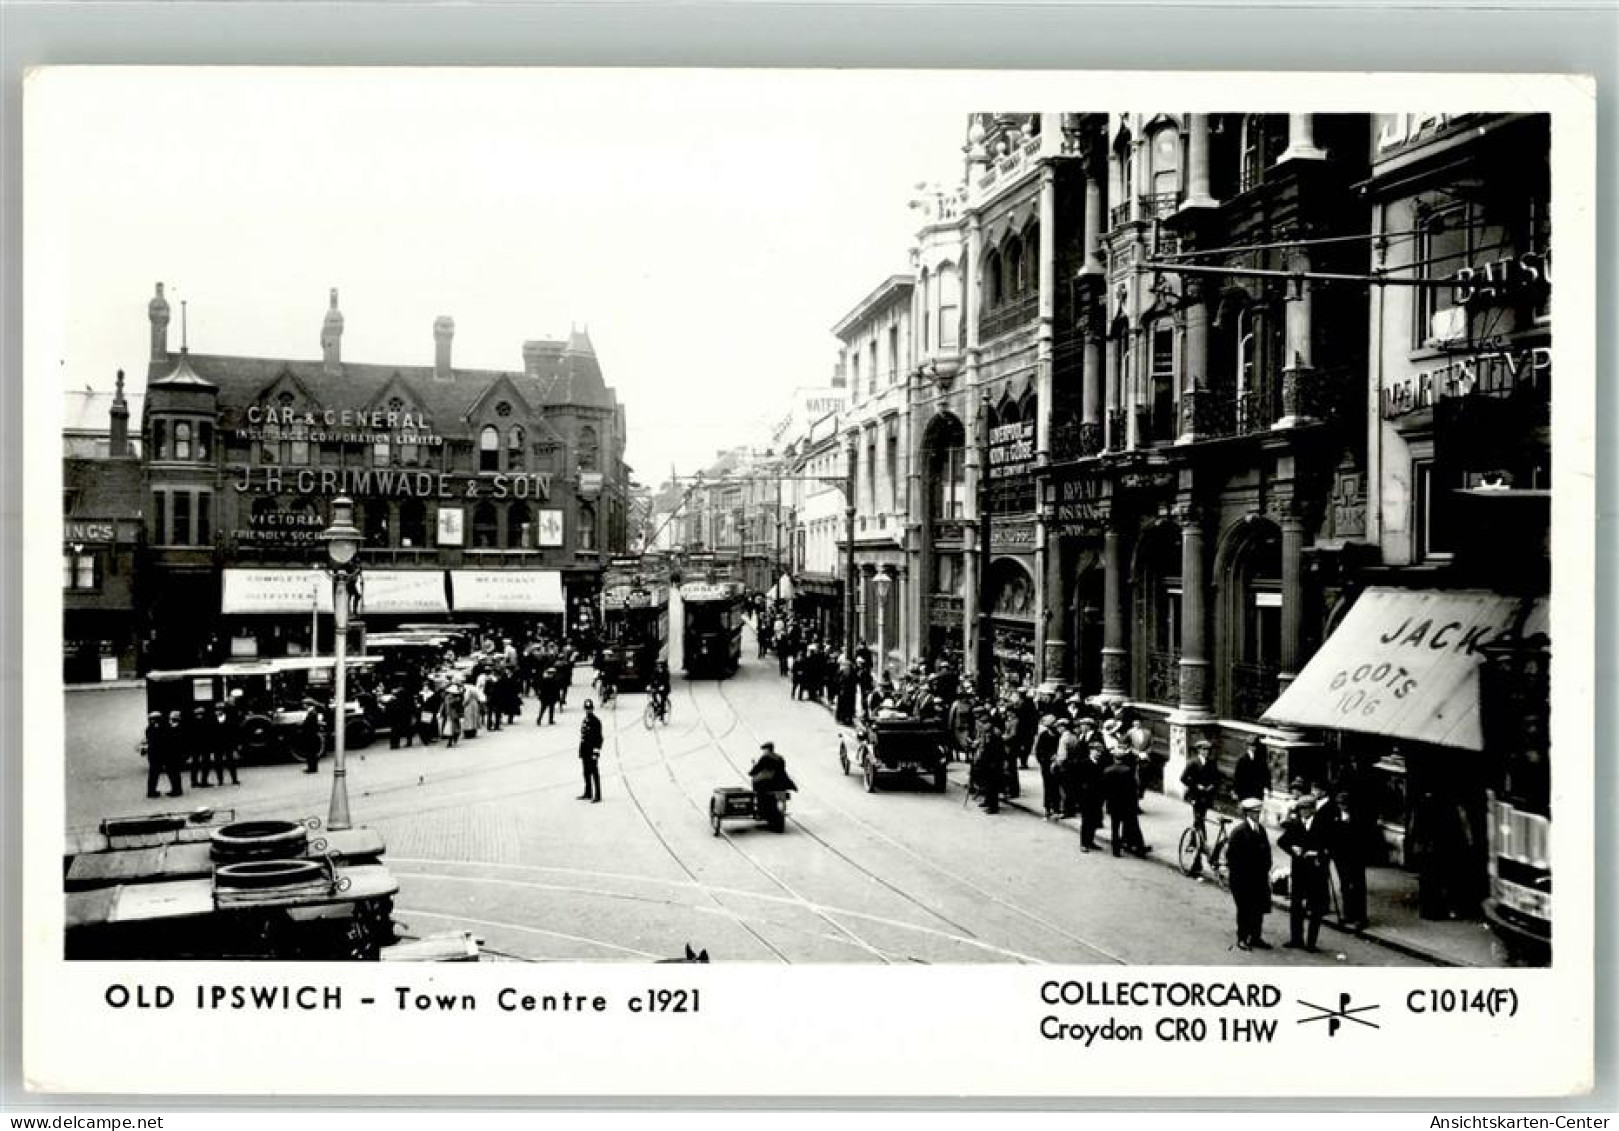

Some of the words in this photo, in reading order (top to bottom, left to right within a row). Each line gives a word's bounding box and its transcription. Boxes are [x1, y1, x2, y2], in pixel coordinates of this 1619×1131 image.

[247, 405, 295, 425] CAR
[305, 412, 316, 426] &
[324, 409, 431, 430] GENERAL
[395, 434, 443, 446] LIMITED
[298, 470, 455, 498] GRIMWADE
[466, 479, 479, 499] &
[492, 473, 551, 500] SON
[249, 513, 325, 526] VICTORIA
